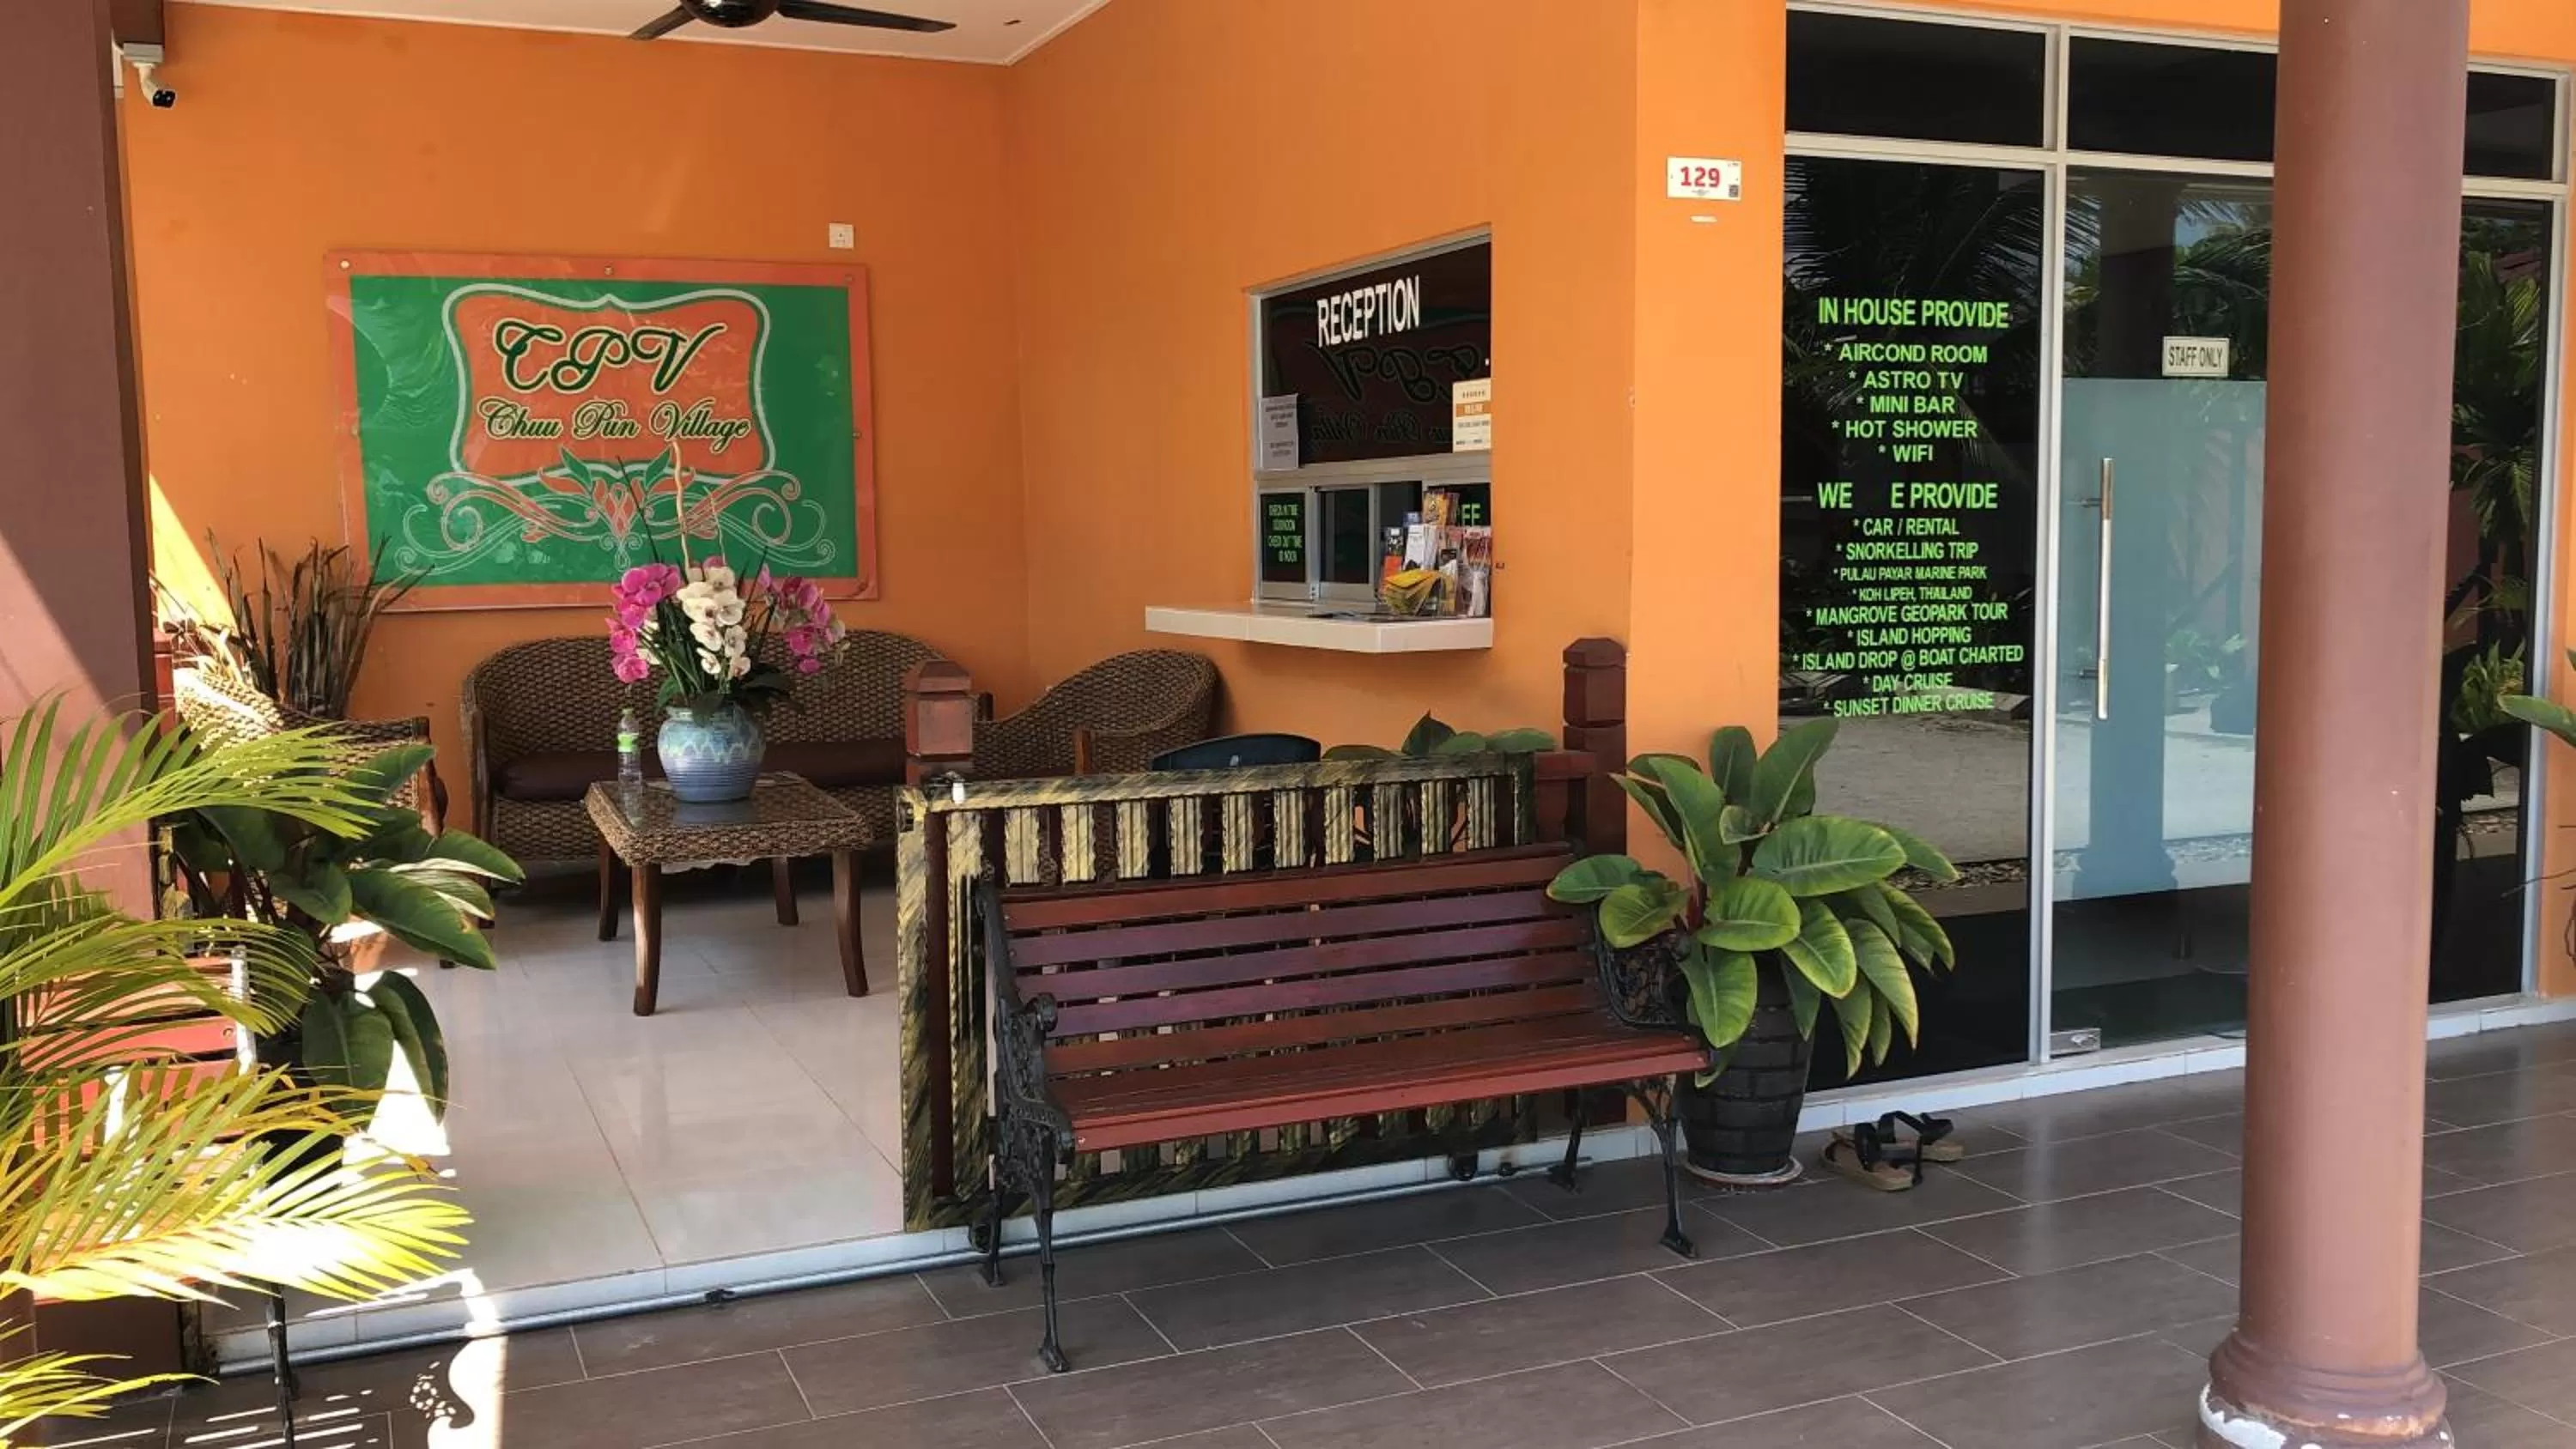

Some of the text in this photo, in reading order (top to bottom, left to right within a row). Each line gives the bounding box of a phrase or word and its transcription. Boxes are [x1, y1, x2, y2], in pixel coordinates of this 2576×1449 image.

[1680, 167, 1720, 187] 129
[1316, 274, 1419, 348] RECEPTION
[1819, 297, 2009, 329] IN HOUSE PROVIDE
[495, 318, 728, 394] CPV
[1838, 343, 1988, 363] AIRCOND ROOM
[2169, 346, 2222, 367] STAFF ONLY
[1863, 371, 1963, 389] ASTRO TV
[1869, 396, 1955, 413] MINI BAR
[478, 398, 752, 453] Chuu Pun Village
[1845, 420, 1978, 438] HOT SHOWER
[1892, 445, 1933, 462] WIFI
[1817, 482, 1854, 509] WE
[1910, 482, 1998, 509] PROVIDE
[1862, 518, 1893, 536] CAR
[1905, 518, 1959, 536] RENTAL
[1846, 542, 1978, 560] SNORKELLING TRIP
[1840, 566, 1987, 581] PULAU PAYAR MARINE PARK
[1859, 588, 1882, 601] KOH
[1919, 586, 1972, 600] THAILAND
[1815, 603, 2008, 625] MANGROVE GEOPARK TOUR
[1856, 627, 1971, 646] ISLAND HOPPING
[1802, 645, 2023, 670] ISLAND DROP @ BOAT CHARTED
[1873, 672, 1953, 692] DAY CRUISE
[1833, 693, 1995, 717] SUNSET DINNER CRUISE
